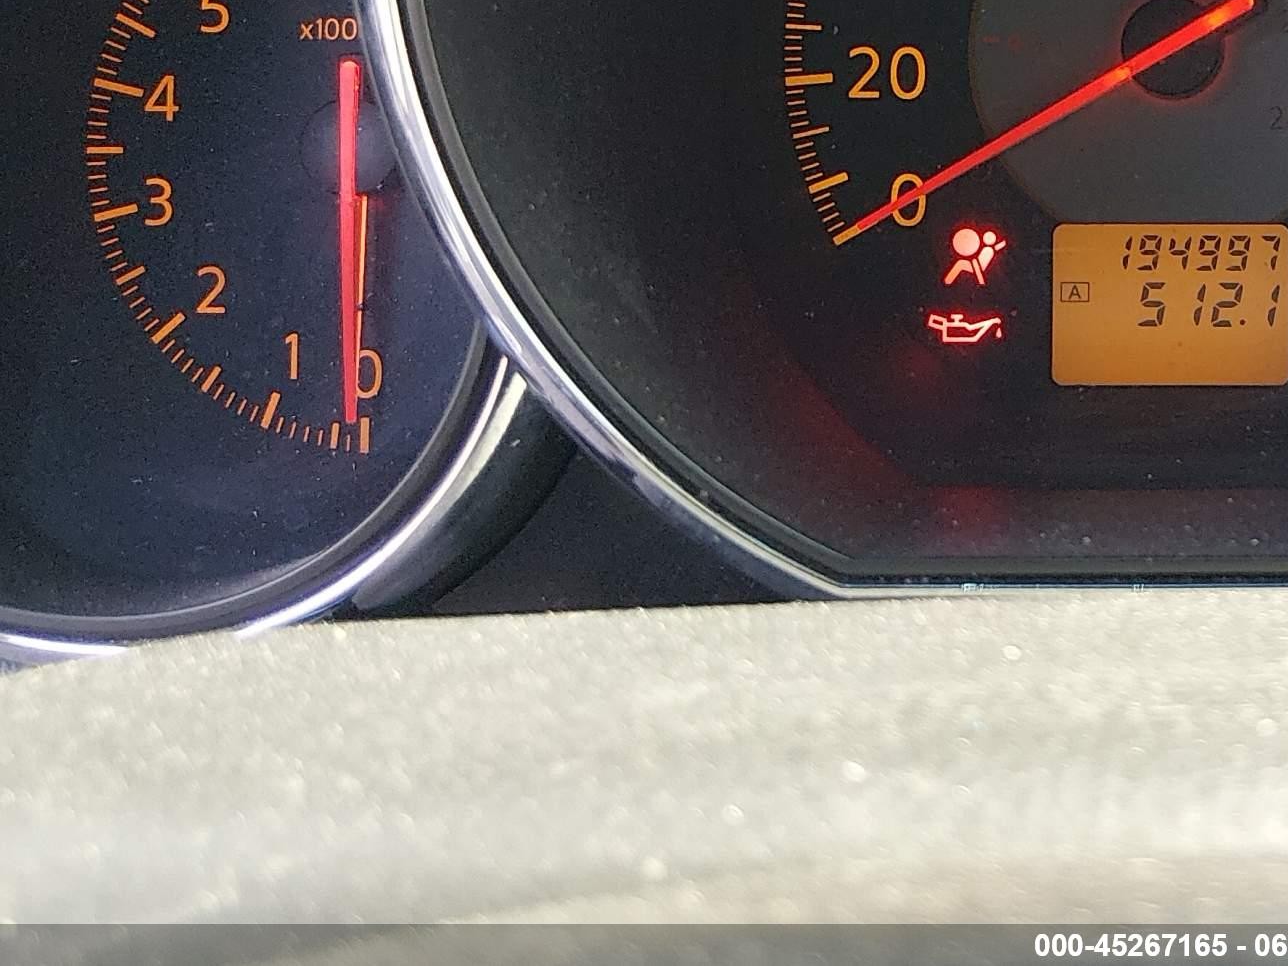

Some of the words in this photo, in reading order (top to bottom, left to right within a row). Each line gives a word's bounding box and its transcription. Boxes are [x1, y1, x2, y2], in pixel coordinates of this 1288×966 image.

[847, 46, 926, 100] 20
[144, 74, 179, 121] 4
[144, 177, 173, 226] 3
[891, 173, 926, 227] 0
[1122, 234, 1281, 272] 194997
[196, 265, 227, 315] 2
[1067, 284, 1082, 300] A
[1137, 282, 1281, 328] 512.1
[285, 333, 299, 380] 1
[357, 349, 383, 399] 0
